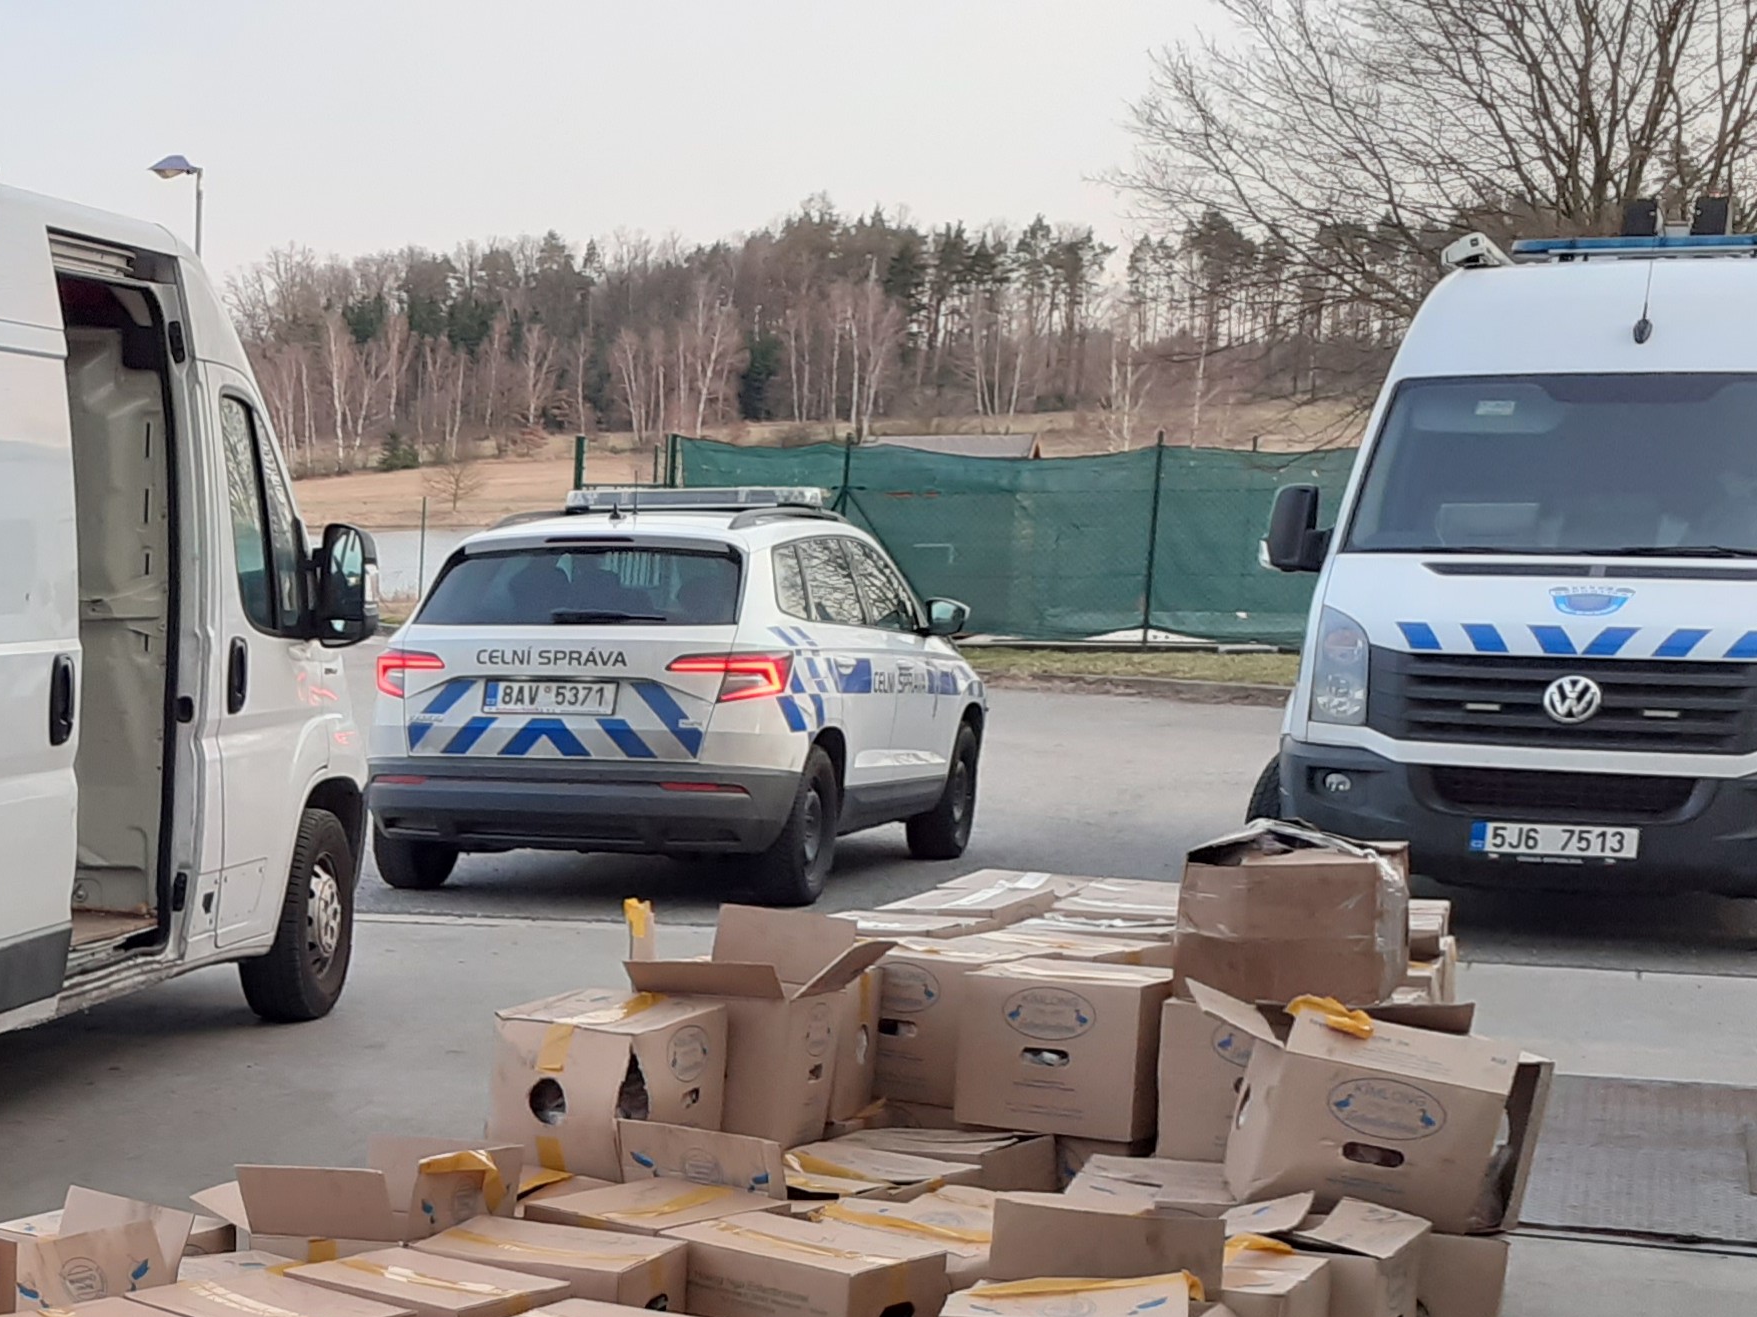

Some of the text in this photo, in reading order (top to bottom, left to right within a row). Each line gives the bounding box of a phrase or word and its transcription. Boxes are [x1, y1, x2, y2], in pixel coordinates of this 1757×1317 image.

[475, 645, 628, 669] CELNÍ SPRÁVA
[501, 685, 606, 707] 8AV 5371
[1492, 826, 1625, 853] 5J6 7513
